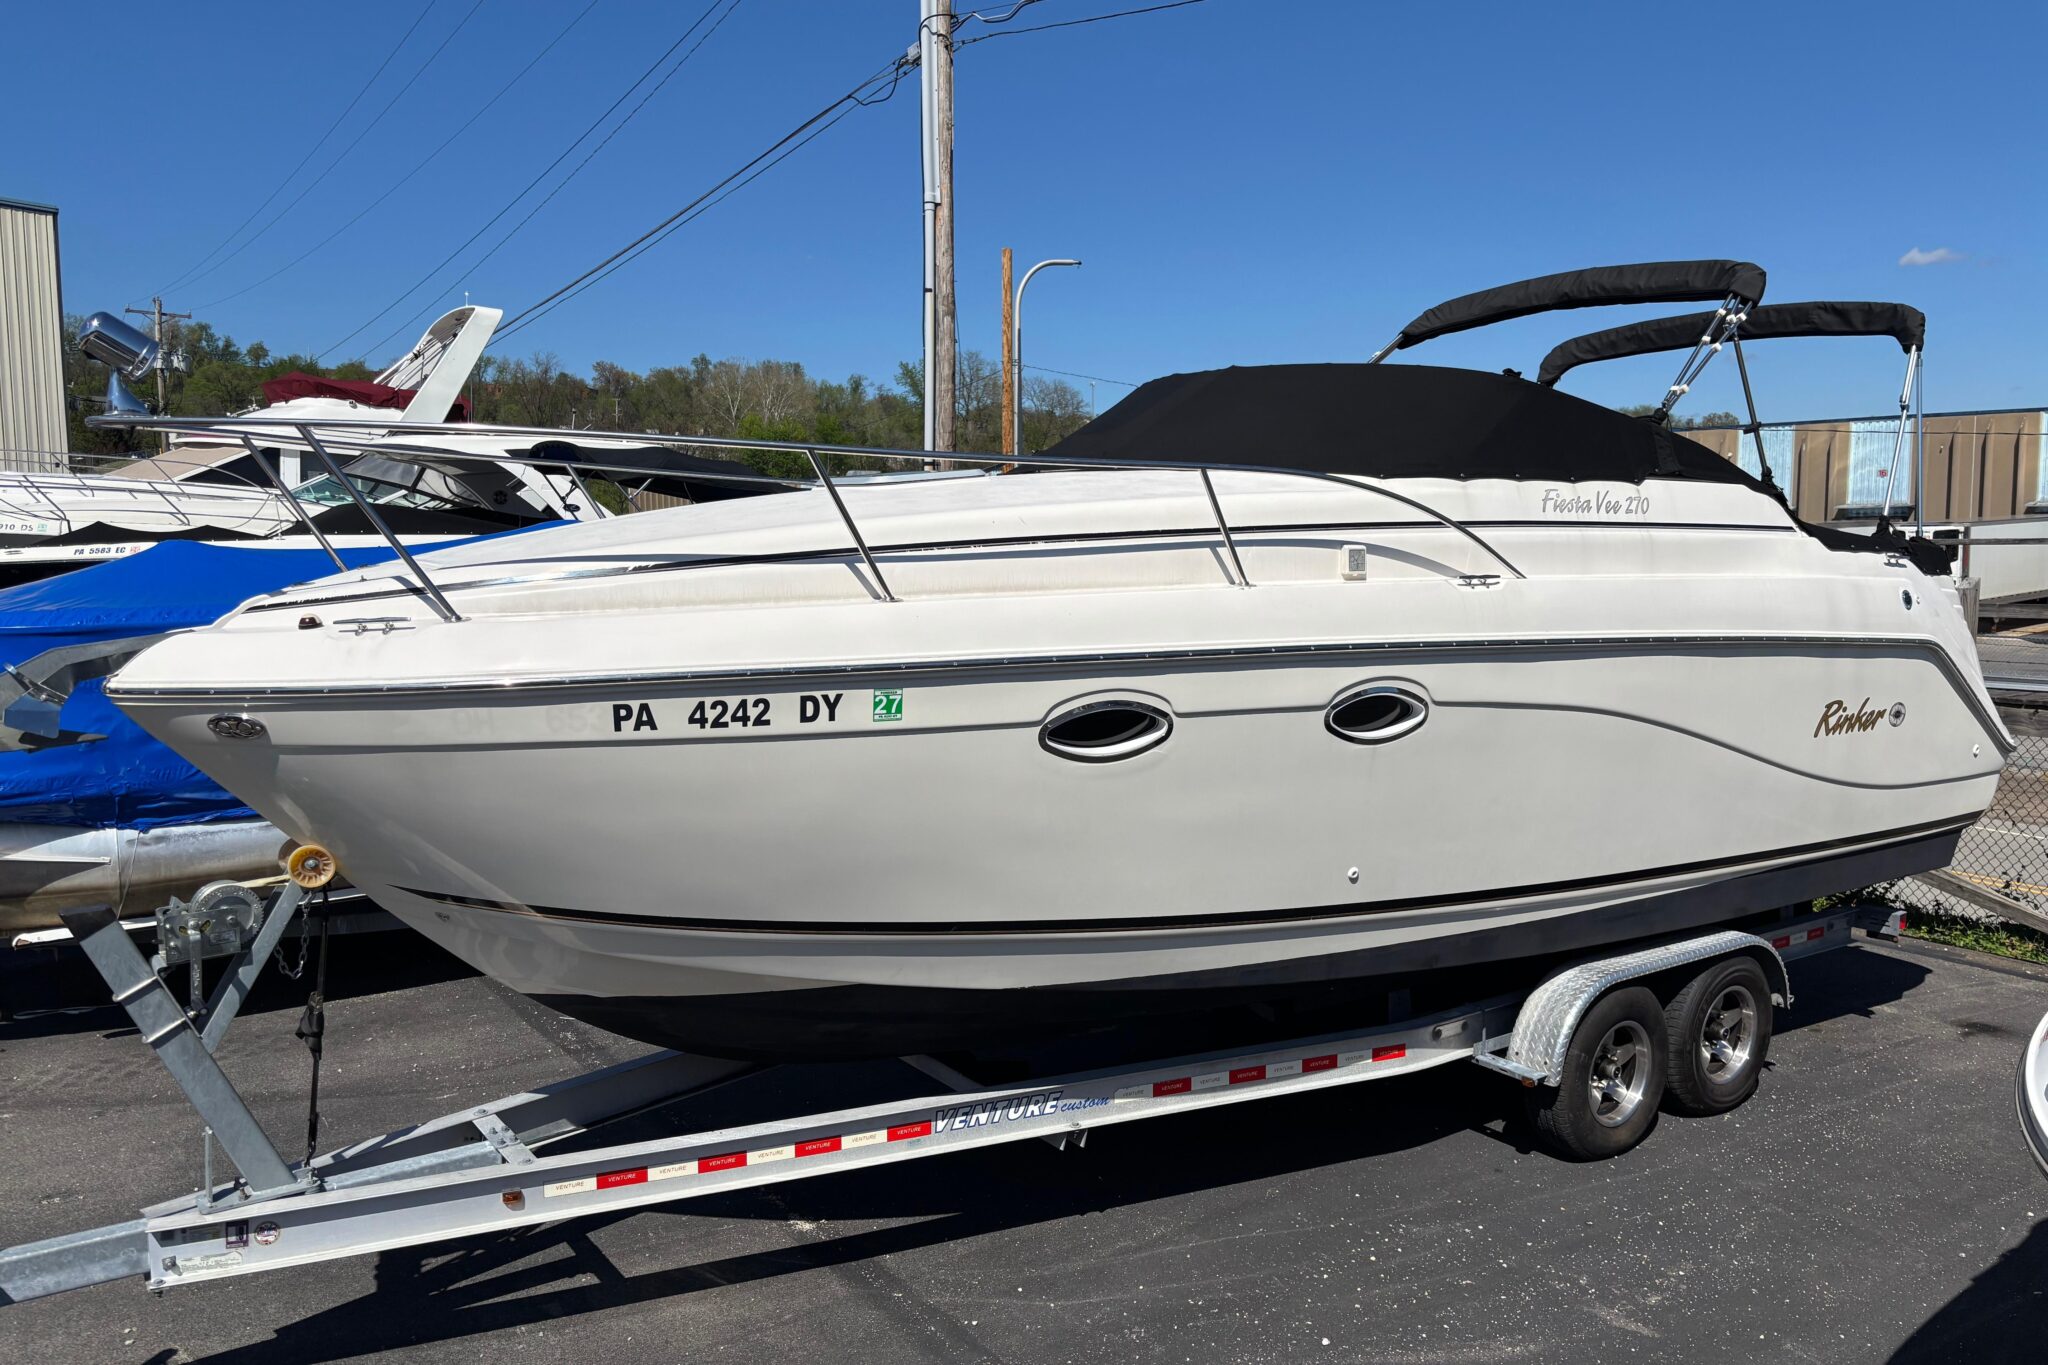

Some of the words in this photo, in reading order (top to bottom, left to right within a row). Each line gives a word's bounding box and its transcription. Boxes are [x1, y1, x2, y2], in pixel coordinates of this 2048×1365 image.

[1542, 488, 1593, 514] Fiesta
[1595, 489, 1622, 515] Vee
[1624, 496, 1650, 515] 270
[74, 548, 85, 556] PA
[874, 695, 902, 714] 27
[612, 703, 658, 732] PA
[687, 697, 771, 730] 4242
[799, 693, 843, 724] DY
[1813, 696, 1888, 739] Rinker
[935, 1090, 1064, 1133] VENTURE
[1060, 1096, 1111, 1113] custom
[897, 1126, 921, 1135] VENTURE
[852, 1133, 877, 1143] VENTURE
[805, 1141, 831, 1150] VENTURE
[758, 1149, 784, 1159] VENTURE
[709, 1158, 737, 1167] VENTURE
[659, 1165, 687, 1174] VENTURE
[607, 1173, 637, 1182] VENTURE
[555, 1181, 585, 1191] VENTURE
